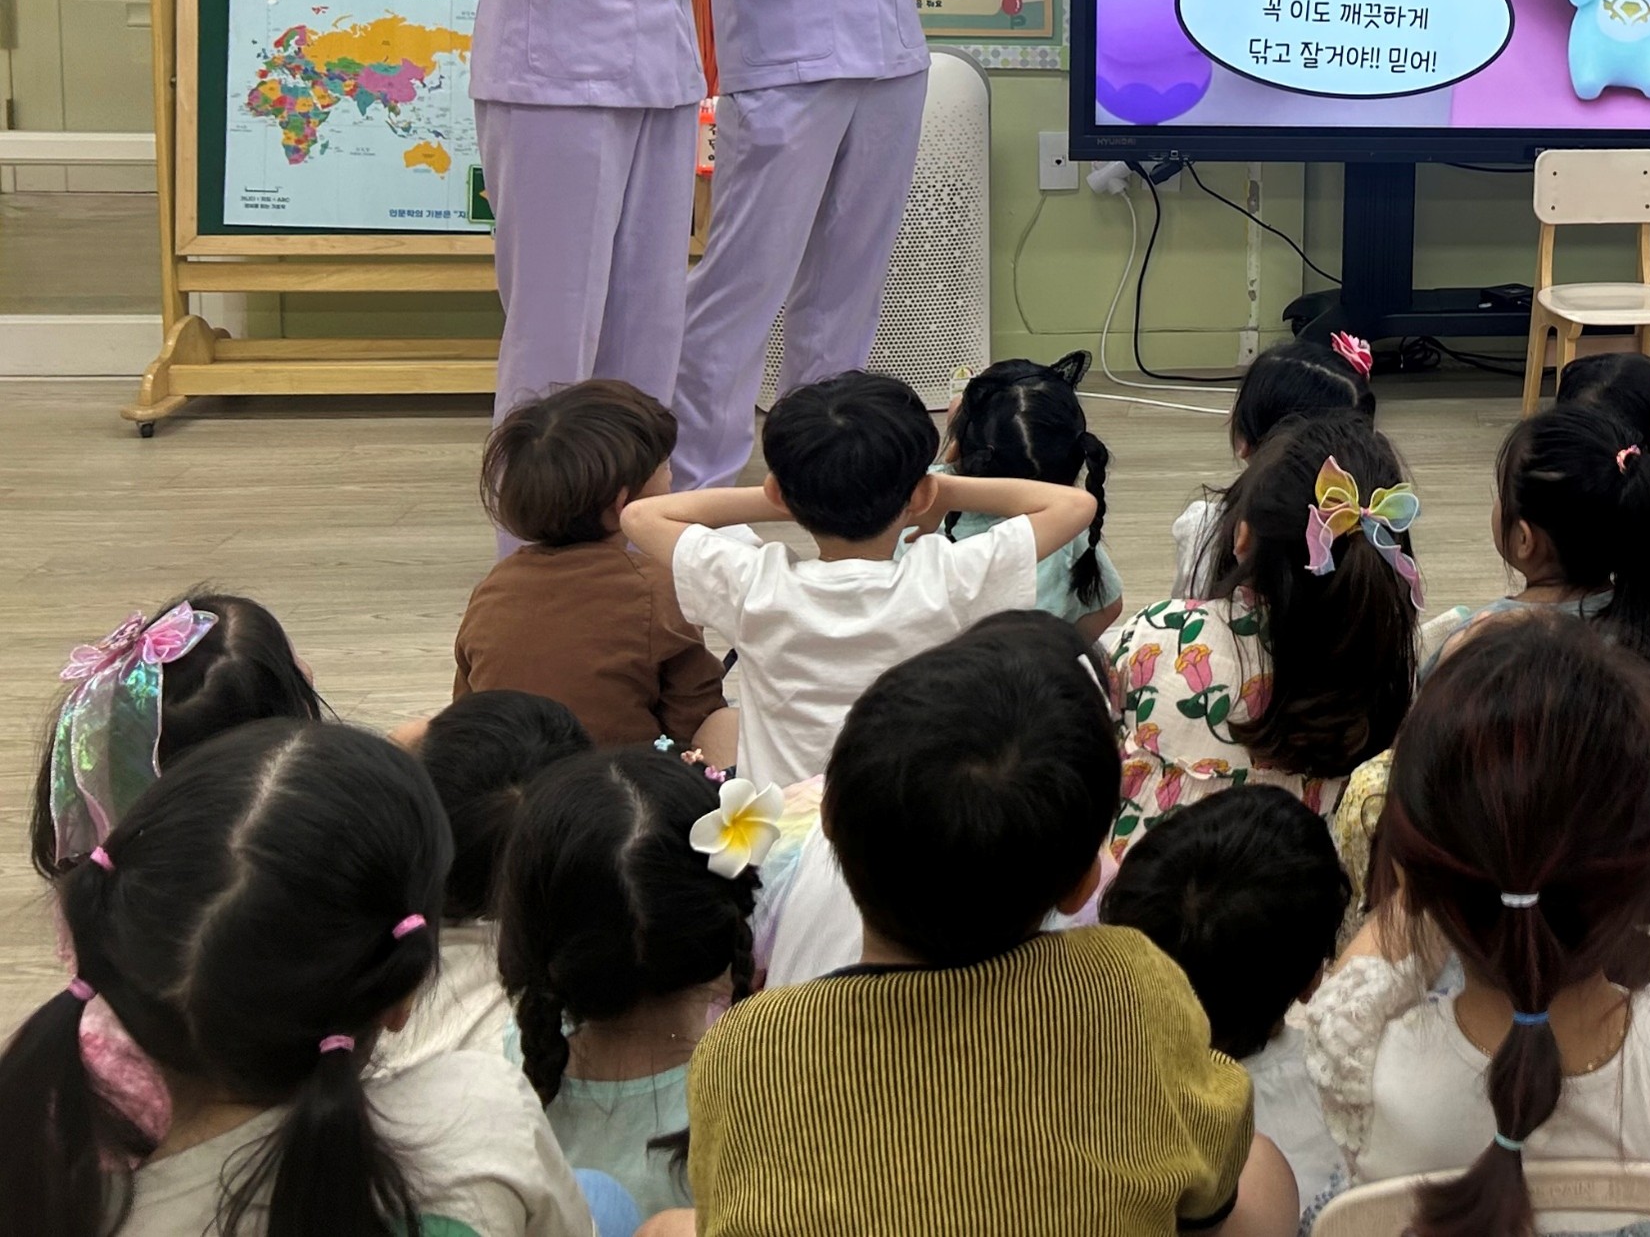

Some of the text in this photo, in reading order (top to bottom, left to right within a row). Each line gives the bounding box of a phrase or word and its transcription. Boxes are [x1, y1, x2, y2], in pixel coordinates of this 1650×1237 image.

[1290, 0, 1331, 23] 이도
[1340, 3, 1429, 30] 깨끗하게
[1249, 39, 1437, 73] 닦고 잘거야!! 믿어!
[1097, 138, 1136, 146] HYUNDAI
